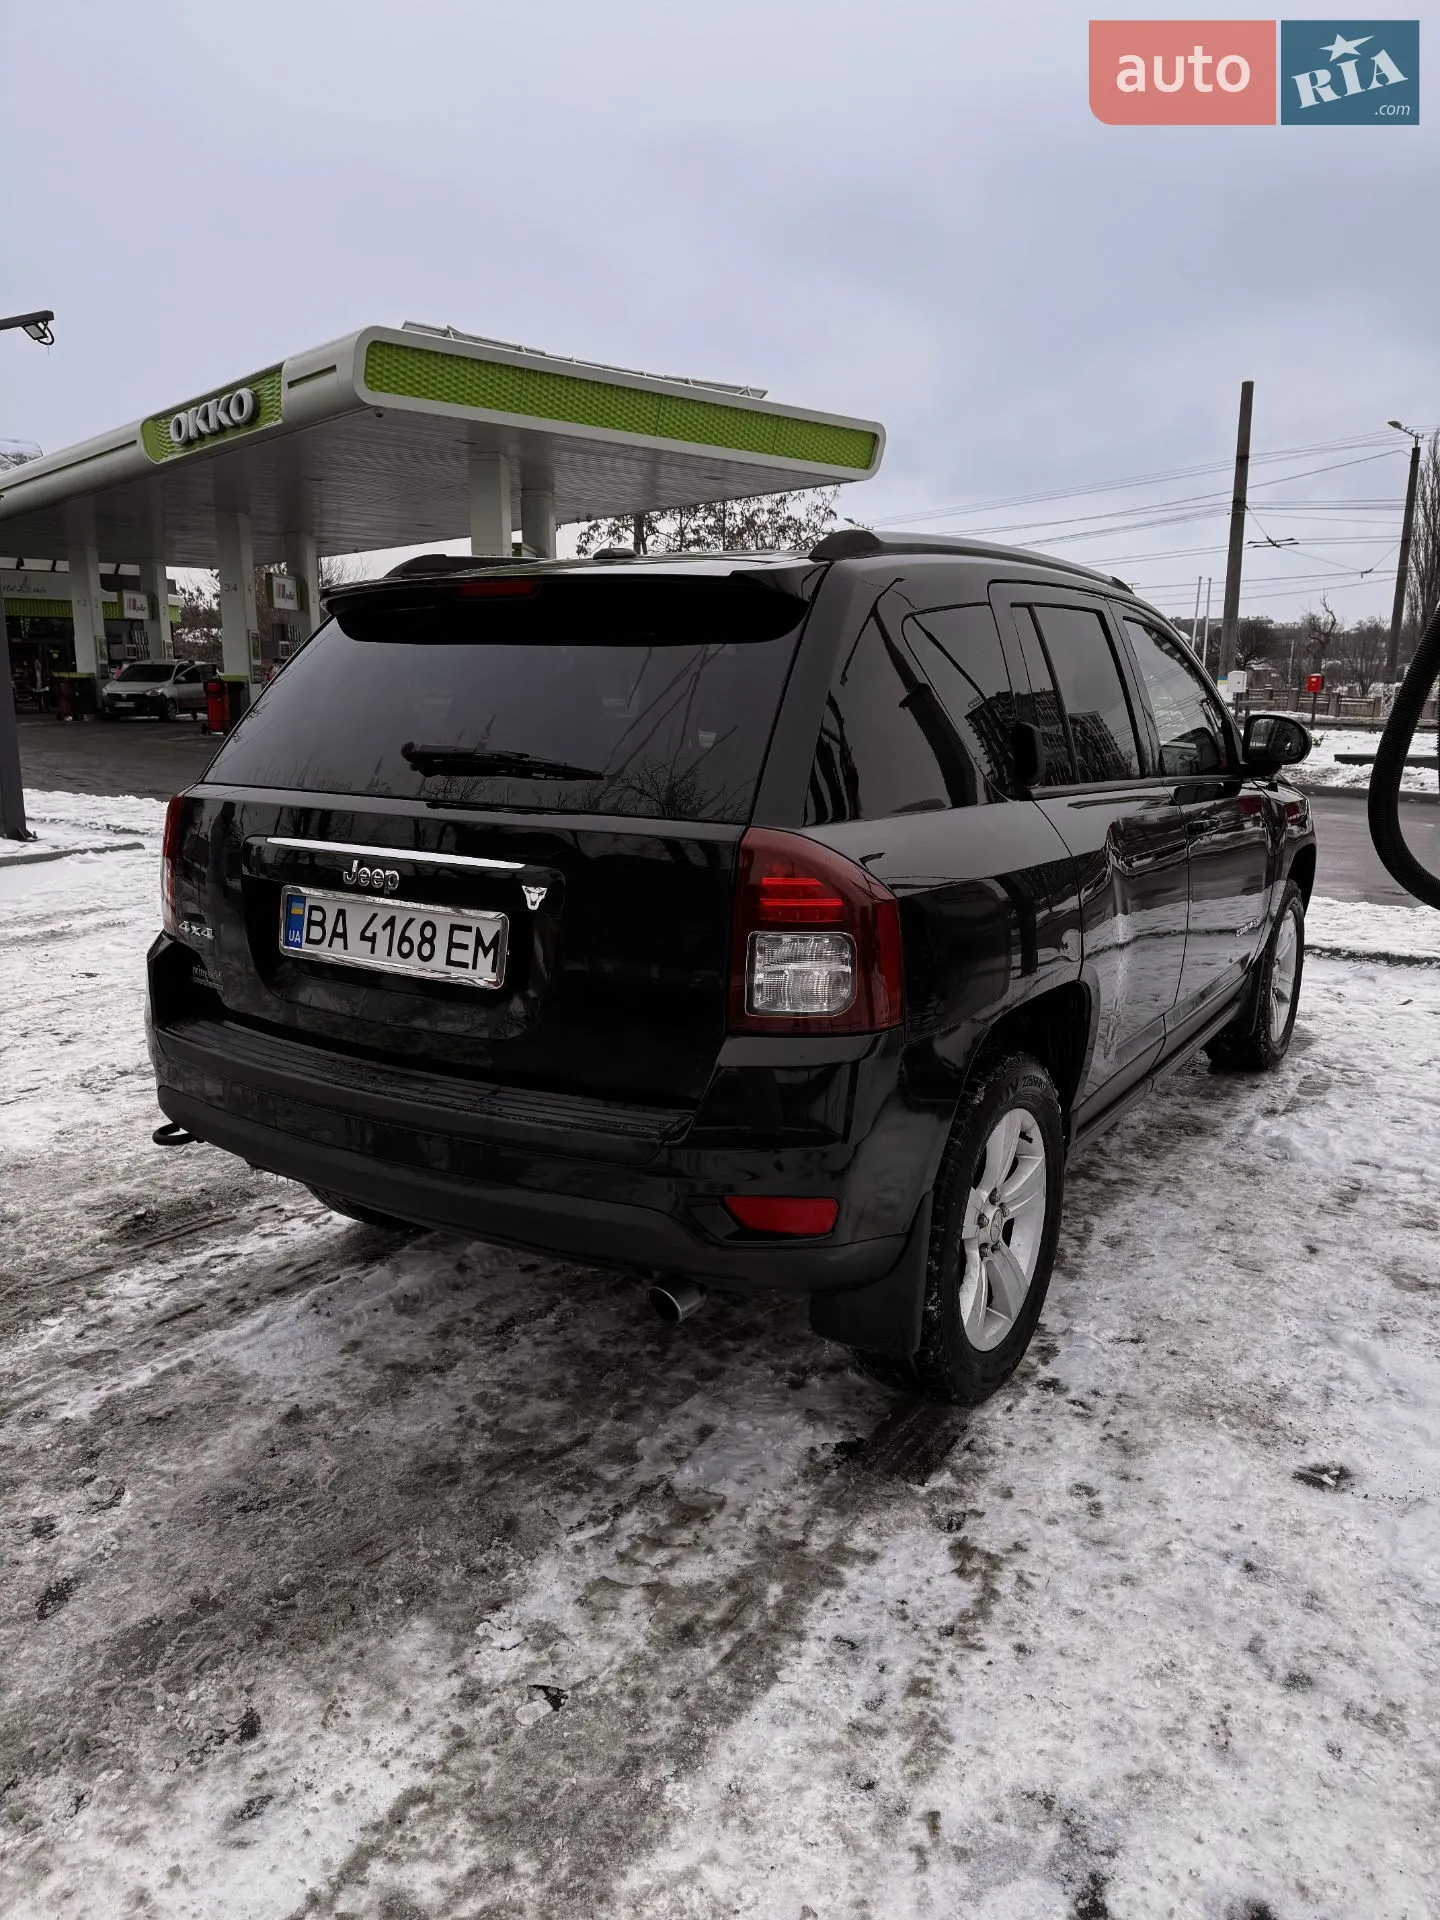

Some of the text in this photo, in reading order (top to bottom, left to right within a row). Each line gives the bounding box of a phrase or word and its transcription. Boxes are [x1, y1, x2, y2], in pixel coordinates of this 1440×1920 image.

[170, 387, 257, 445] OKKO
[342, 859, 400, 894] Jeep
[288, 929, 301, 943] UA
[305, 904, 500, 974] BA 4168 EM
